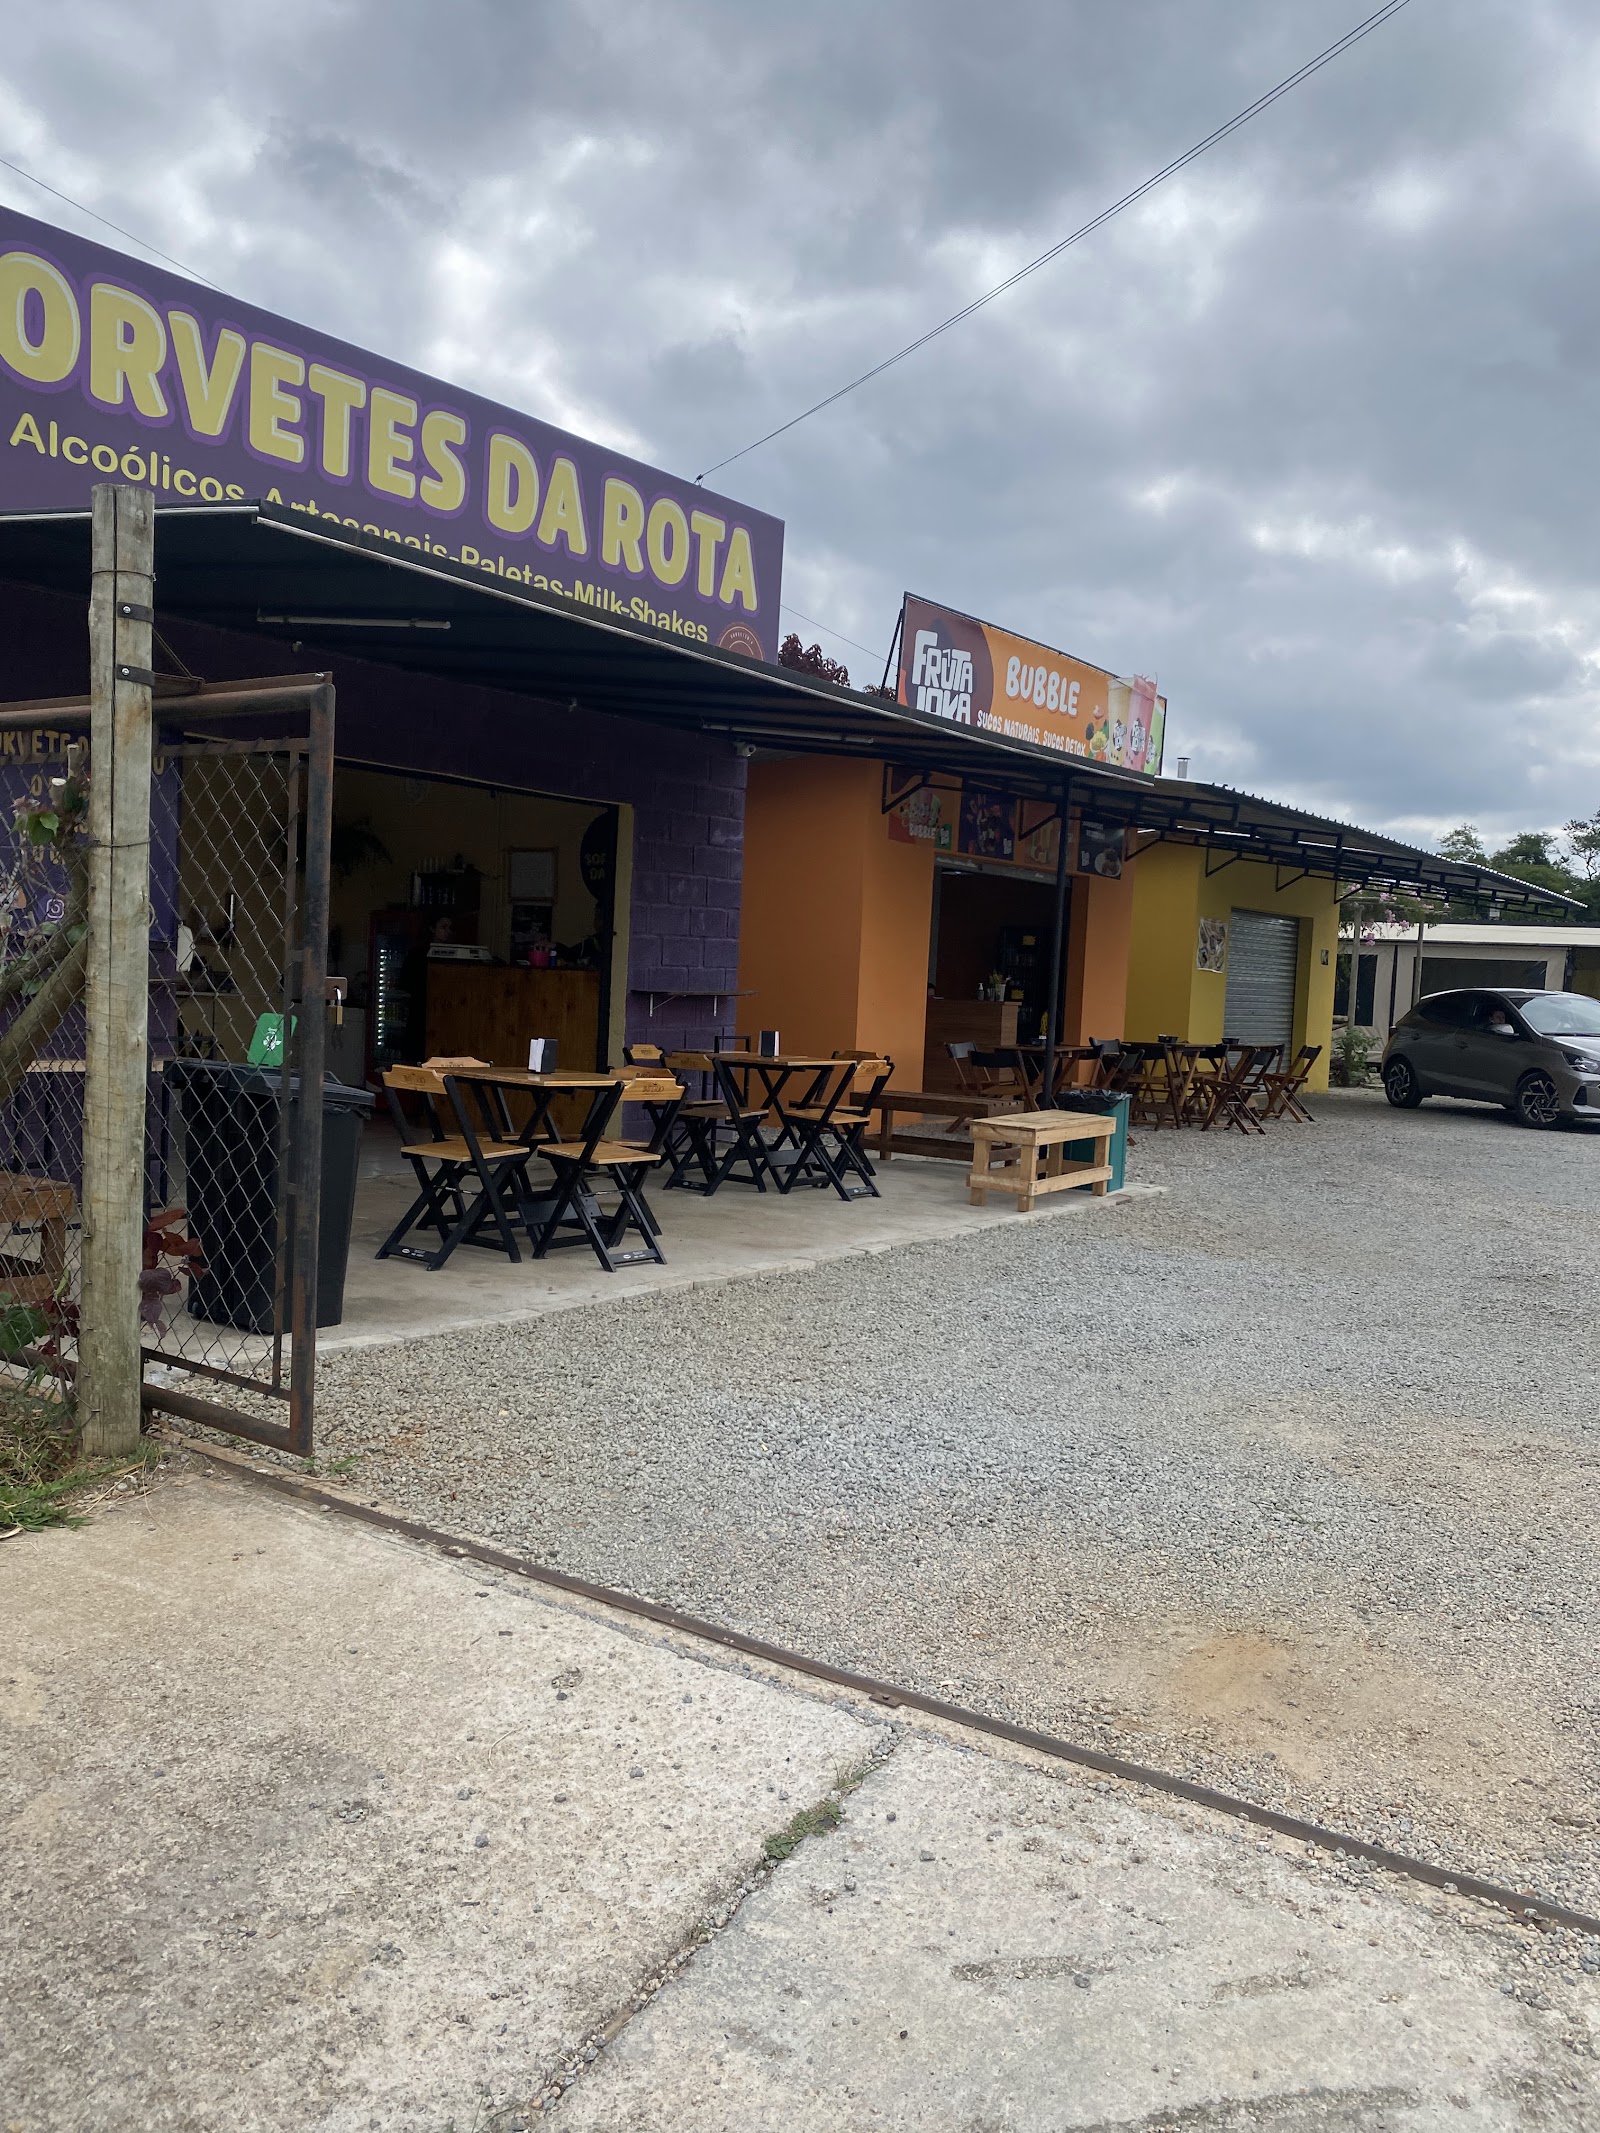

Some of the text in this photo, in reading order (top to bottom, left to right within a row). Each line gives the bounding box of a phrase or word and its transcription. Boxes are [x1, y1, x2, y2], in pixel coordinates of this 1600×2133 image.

[487, 433, 587, 555] DA
[601, 478, 758, 612] ROTA
[912, 629, 973, 693] FRUTA
[1006, 655, 1081, 716] BUBBLE
[976, 709, 1003, 732] SUCOS
[1043, 730, 1065, 751] SUCOS
[1065, 736, 1087, 757] DETOX
